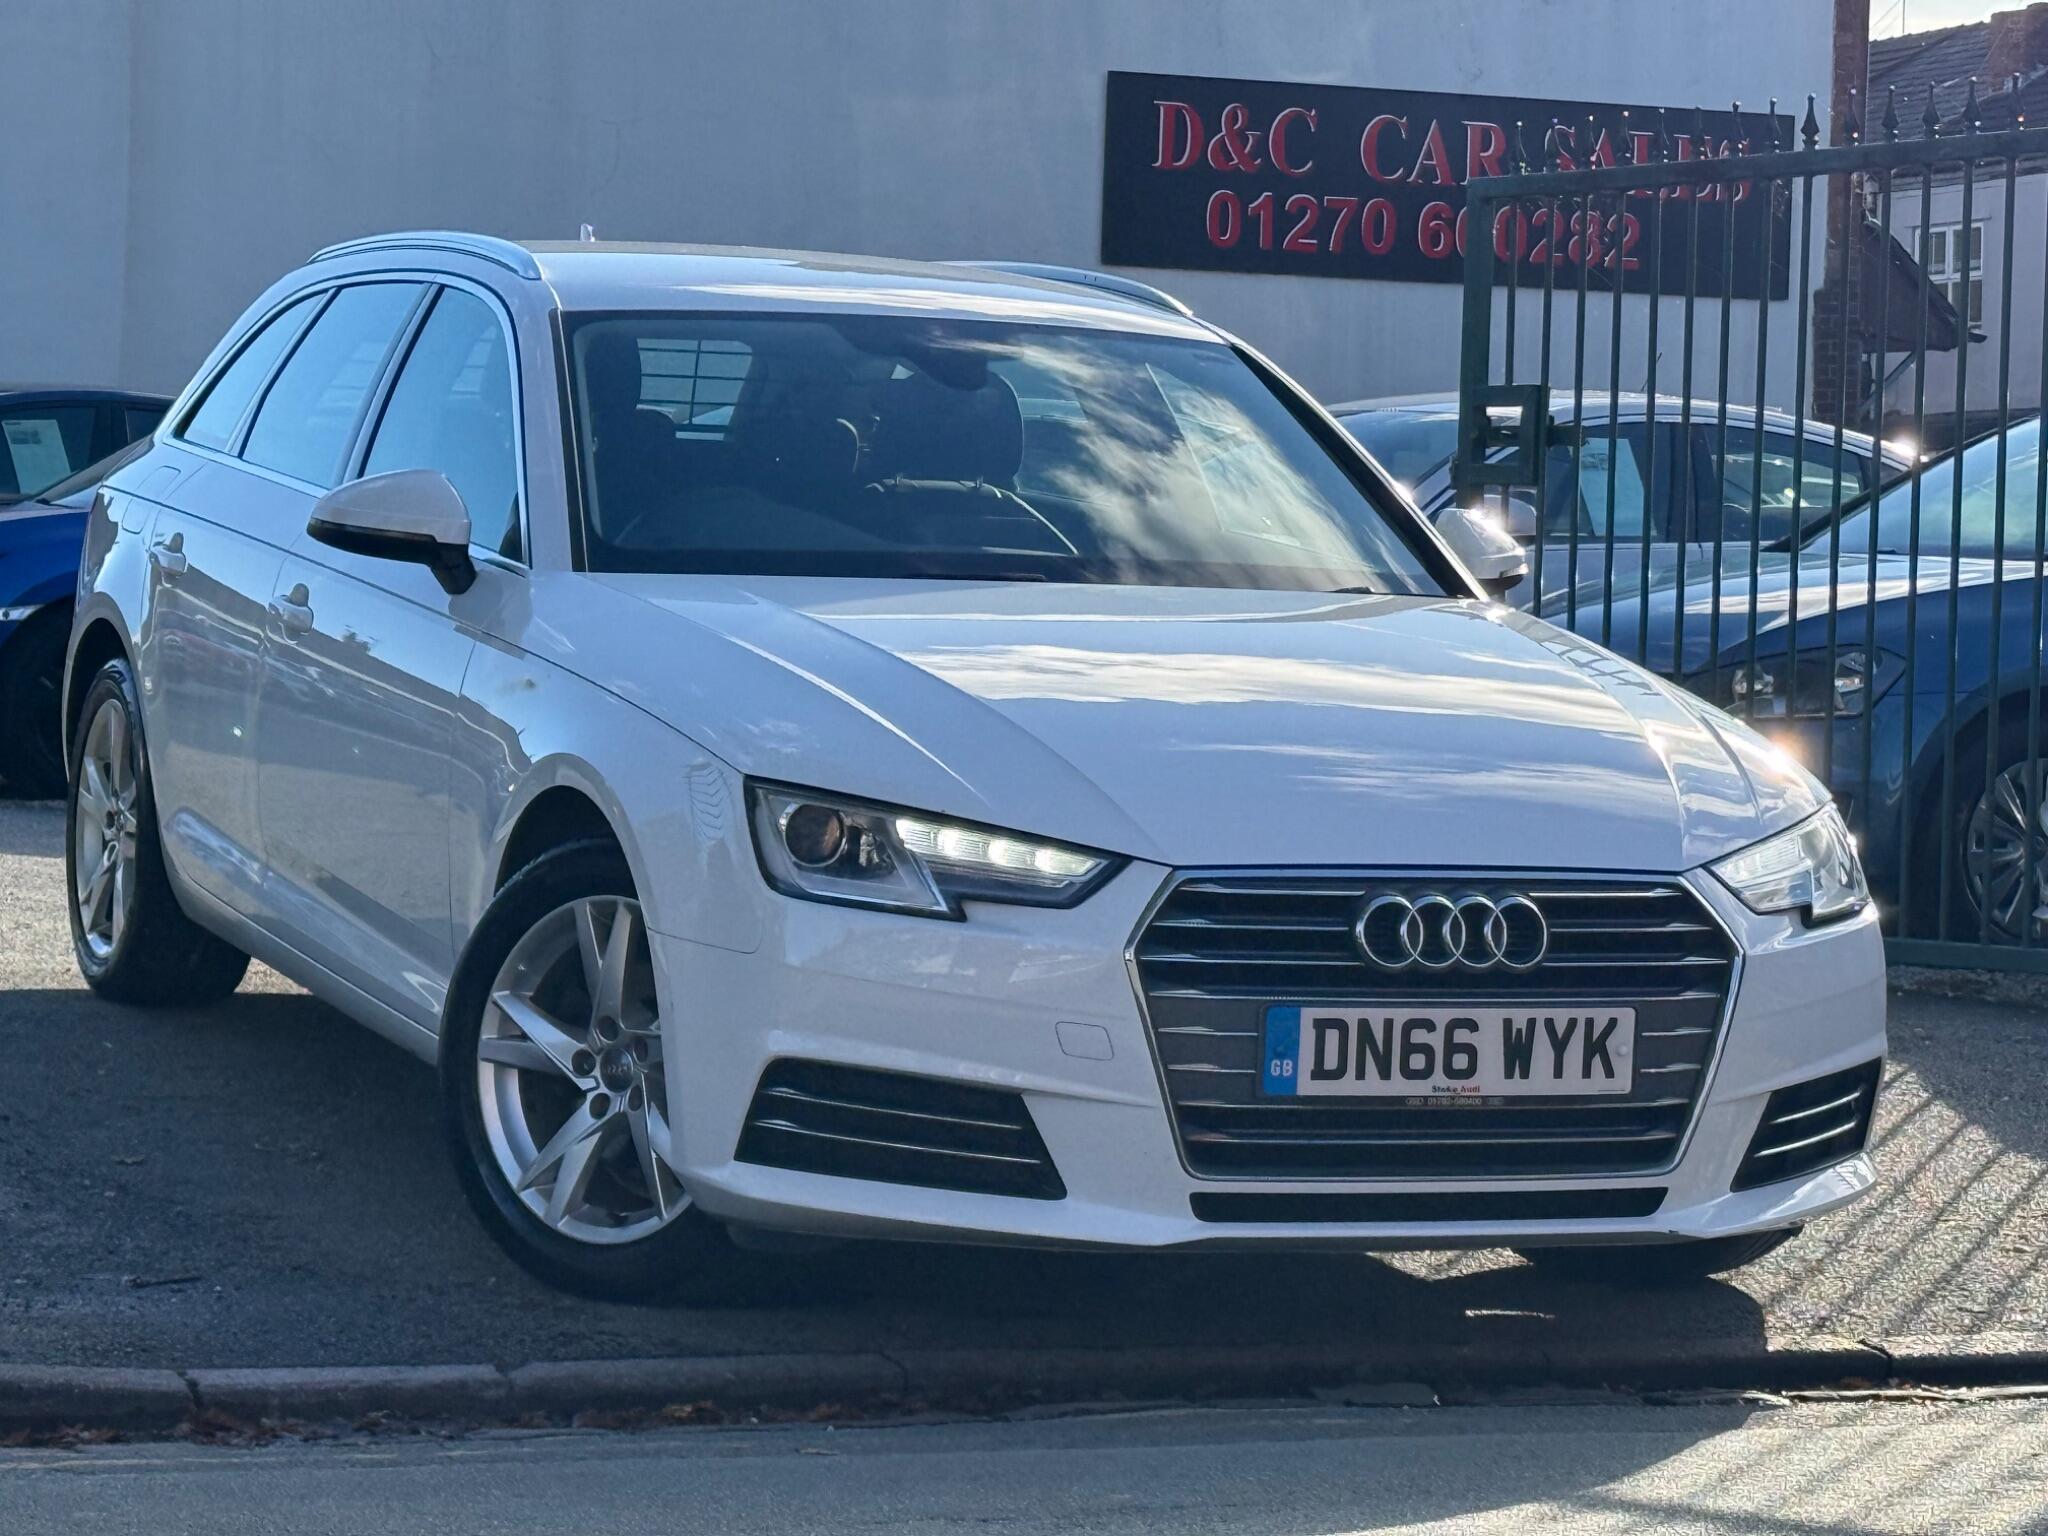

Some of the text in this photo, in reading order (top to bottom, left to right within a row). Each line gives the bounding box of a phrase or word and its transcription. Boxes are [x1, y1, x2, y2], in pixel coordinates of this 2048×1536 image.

[1151, 99, 1319, 176] D&C
[1360, 114, 1507, 186] CAR
[1206, 189, 1641, 270] 01270 60282
[1270, 1059, 1293, 1077] GB
[1310, 1017, 1618, 1081] DN66 WYK
